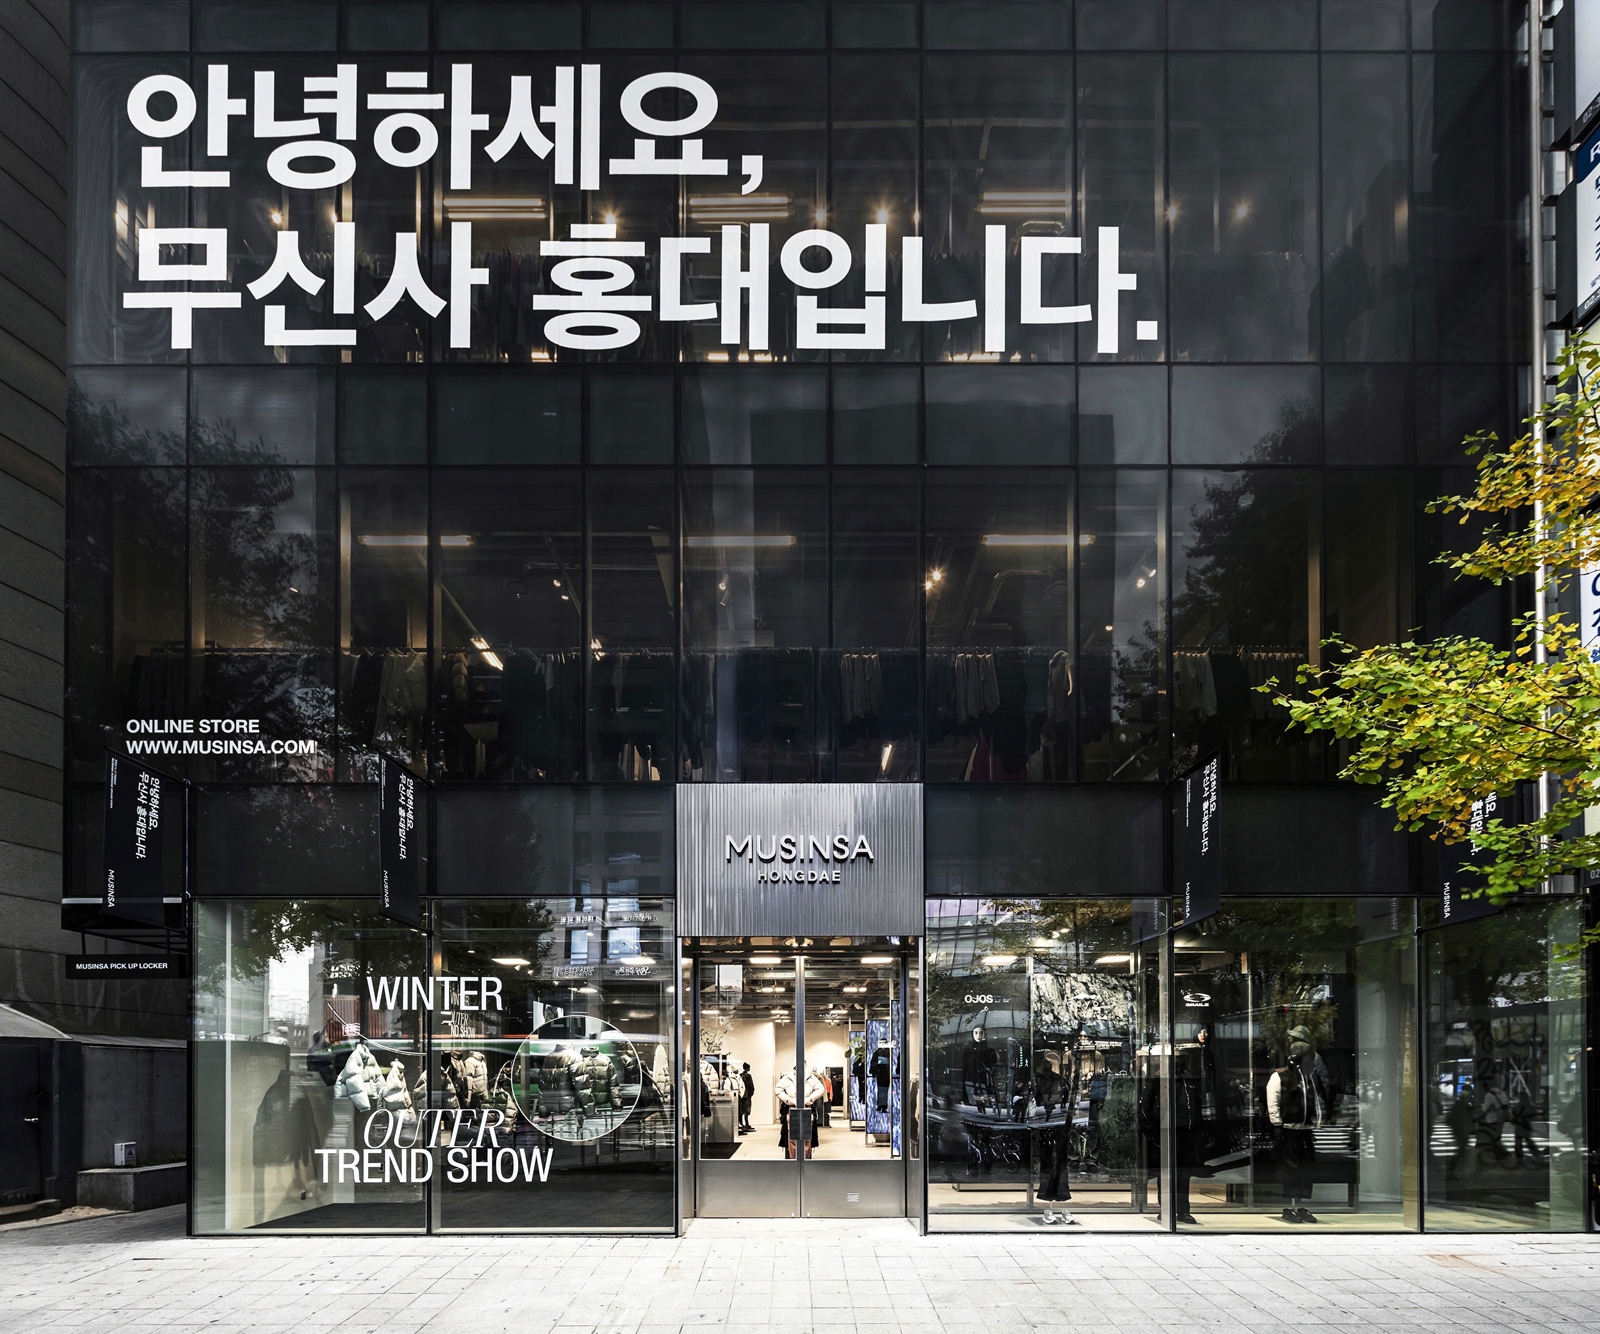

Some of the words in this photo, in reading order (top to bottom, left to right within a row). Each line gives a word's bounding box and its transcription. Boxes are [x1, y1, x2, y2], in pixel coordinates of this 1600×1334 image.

[127, 63, 763, 195] 안녕하세요,
[123, 222, 489, 349] 무신사
[533, 223, 1158, 353] 홍대입니다.
[126, 719, 194, 734] ONLINE
[199, 719, 260, 734] STORE
[126, 740, 315, 754] WWW.MUSINSA.COM
[137, 771, 149, 804] 무신사
[399, 772, 407, 804] 무신사
[1202, 764, 1210, 798] 무신사
[1209, 758, 1217, 818] 안녕하세요,
[148, 777, 160, 830] 안녕하세요,
[406, 777, 414, 831] 안녕하세요,
[136, 806, 148, 859] 홍대입니다.
[398, 807, 407, 860] 홍대입니다.
[1201, 799, 1210, 856] 홍대입니다.
[725, 834, 875, 862] MUSINSA
[107, 869, 115, 908] MUSINSA
[758, 870, 841, 883] HONGDAE
[1443, 881, 1451, 919] MUSINSA
[366, 976, 503, 1010] WINTER
[964, 994, 993, 1003] OJOS
[363, 1108, 505, 1149] OUTER
[315, 1148, 433, 1183] TREND
[447, 1148, 553, 1183] SHOW
